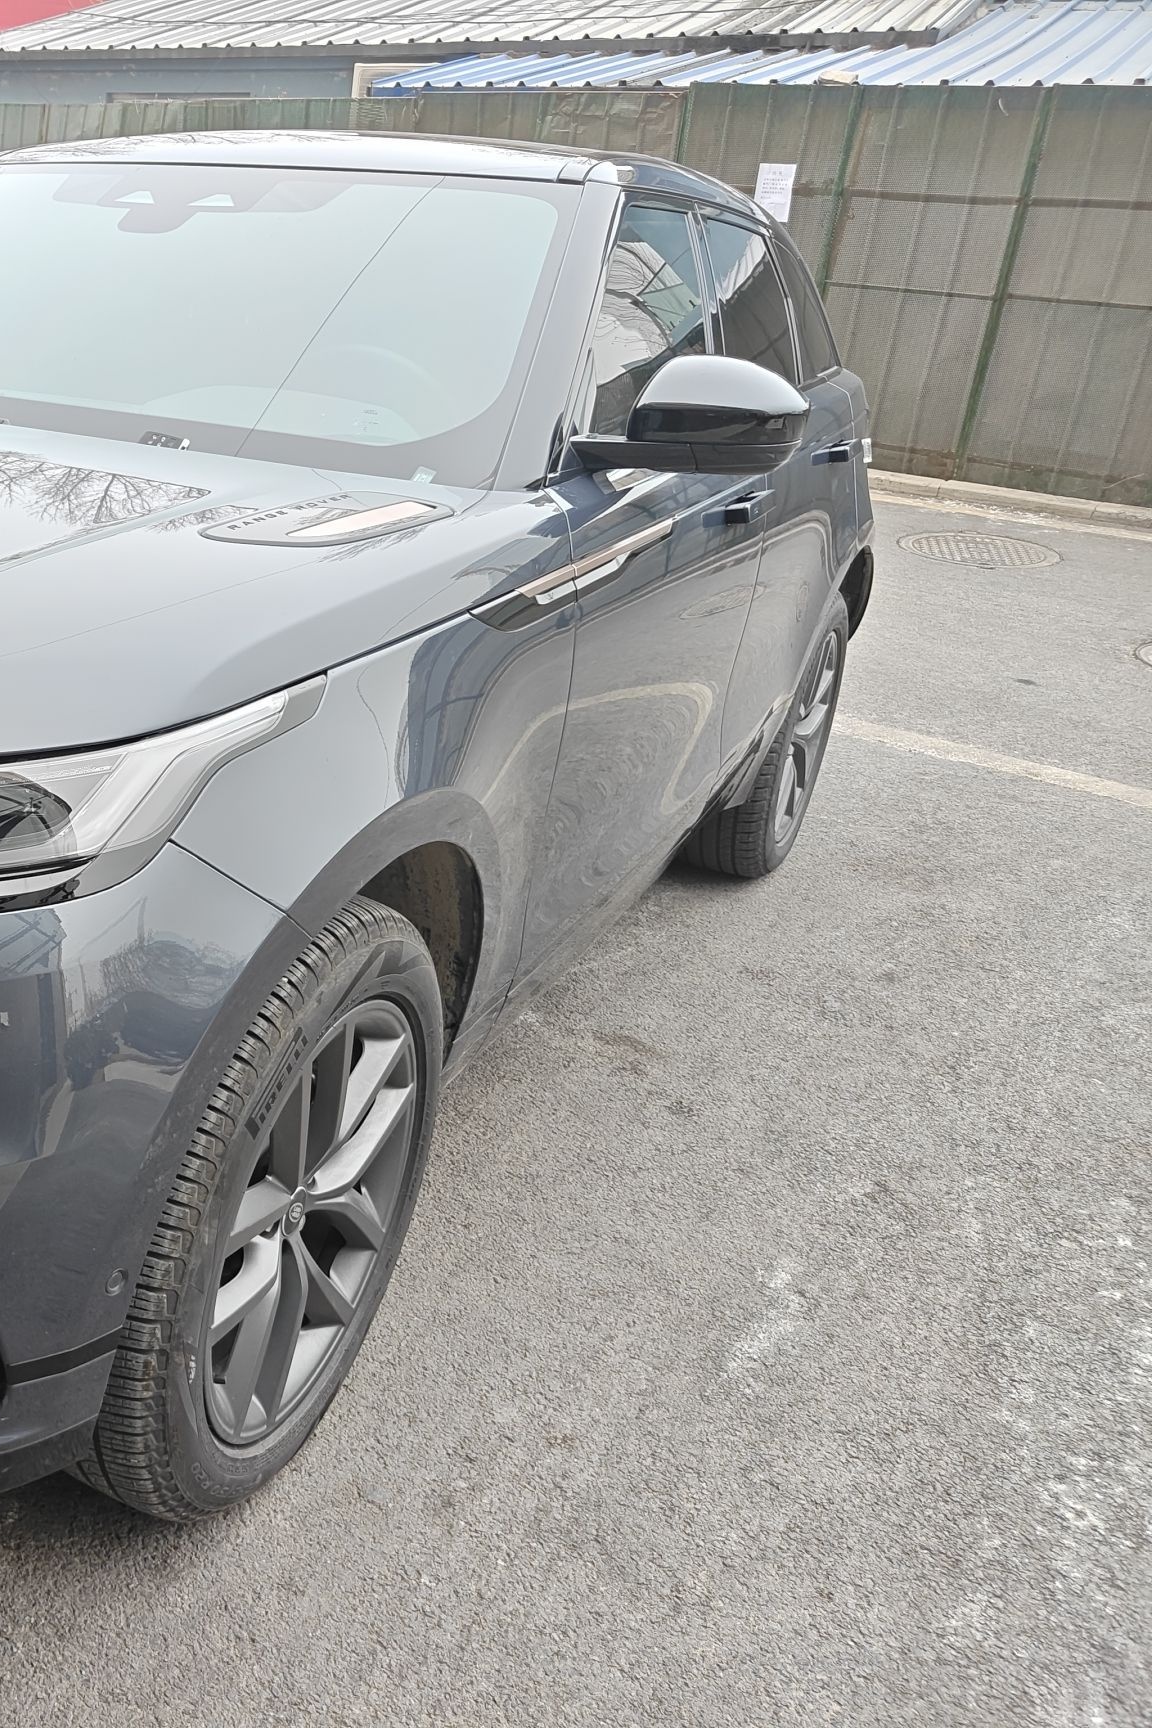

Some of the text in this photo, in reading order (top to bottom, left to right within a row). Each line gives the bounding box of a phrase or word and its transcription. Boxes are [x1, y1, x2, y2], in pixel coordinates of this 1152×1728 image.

[227, 494, 353, 531] RANGE ROVER
[244, 1026, 309, 1141] PIRELLI
